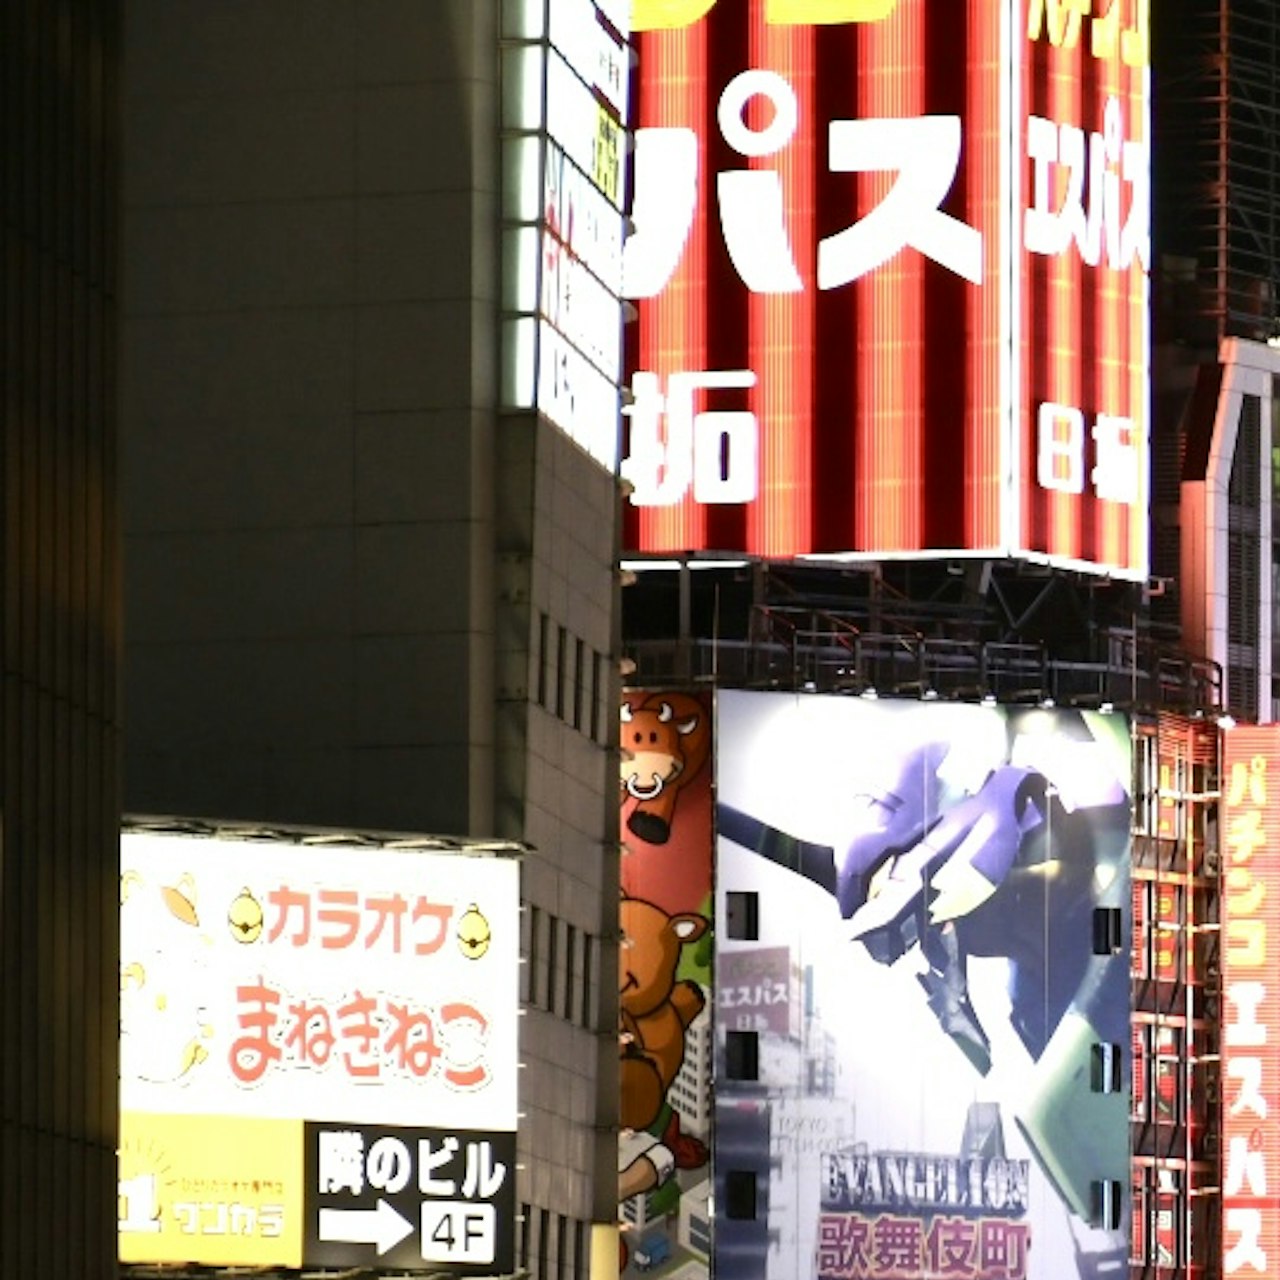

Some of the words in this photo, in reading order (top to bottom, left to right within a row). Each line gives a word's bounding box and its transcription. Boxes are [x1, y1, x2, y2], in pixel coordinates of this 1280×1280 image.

[1025, 95, 1150, 273] エスパス
[267, 885, 453, 956] カラオケ
[228, 974, 488, 1087] まねきねこ
[318, 1131, 506, 1199] 隣のビル
[825, 1154, 1030, 1209] EVANGELION
[430, 1212, 484, 1252] 4F
[818, 1214, 1031, 1280] 歌舞伎町
